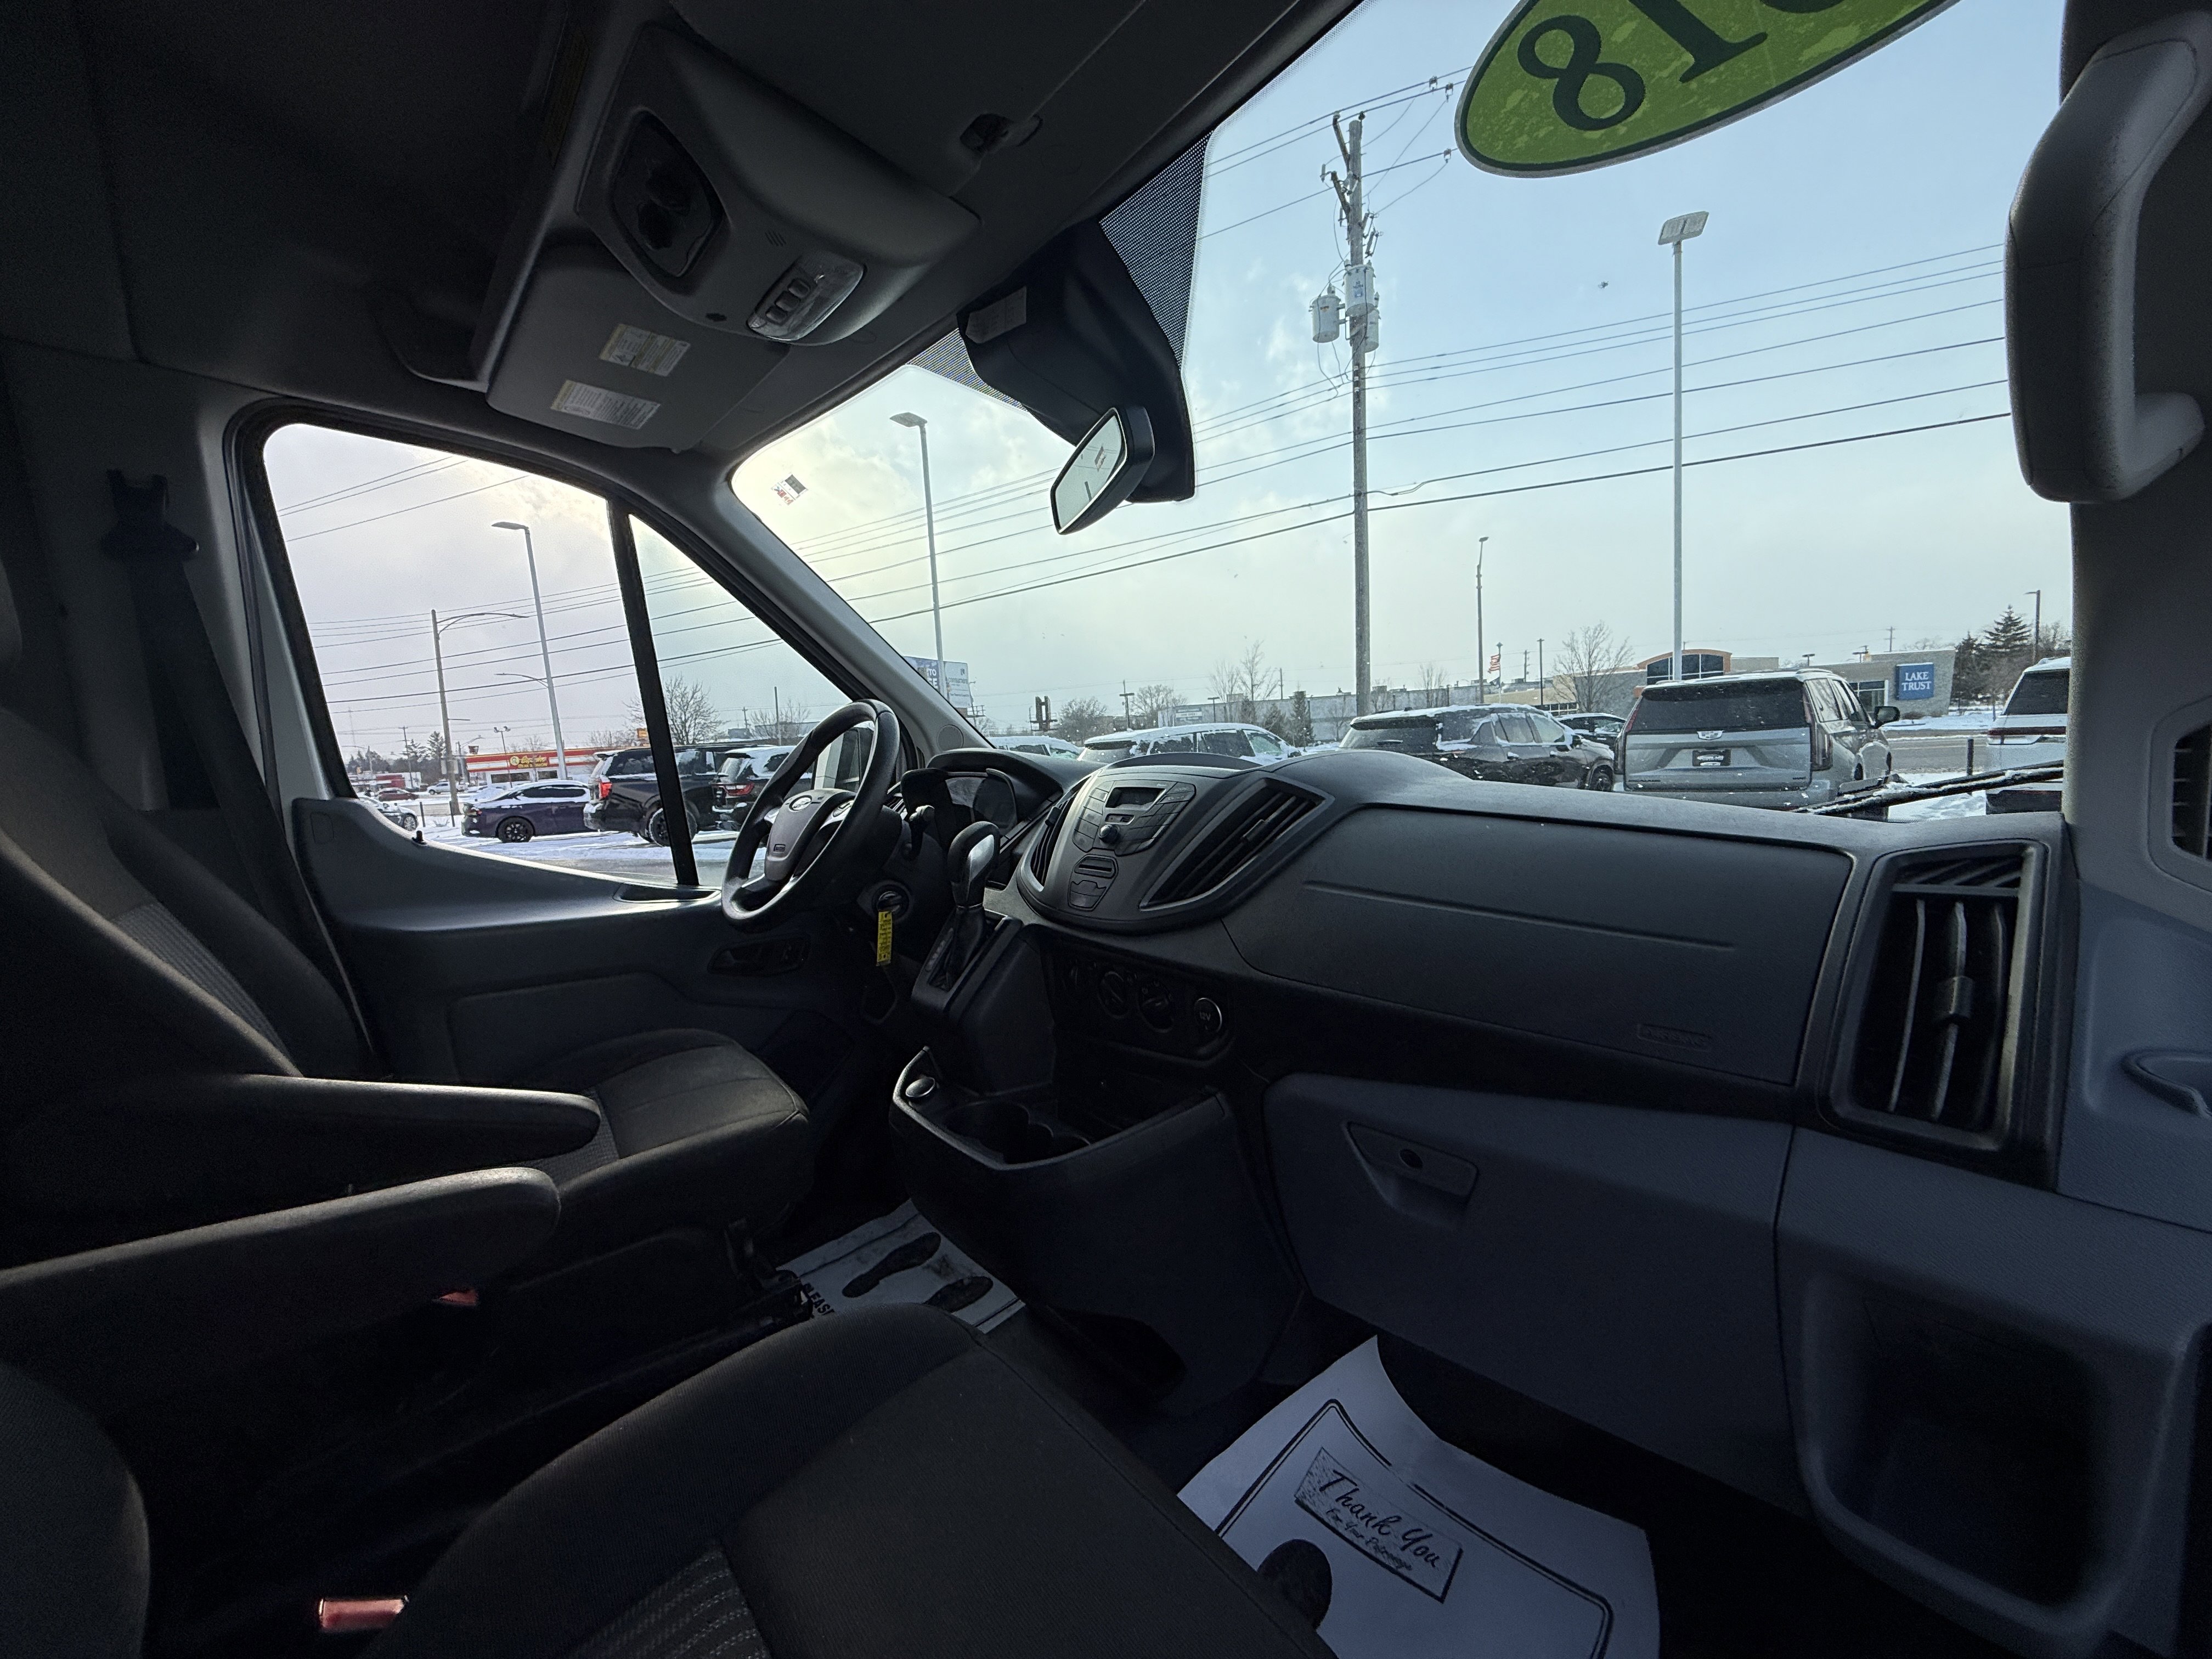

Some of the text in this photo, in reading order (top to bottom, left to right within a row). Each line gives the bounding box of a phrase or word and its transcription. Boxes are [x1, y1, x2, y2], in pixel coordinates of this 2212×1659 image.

[1905, 672, 1929, 681] LAKE
[1901, 681, 1932, 691] TRUST
[1319, 1469, 1440, 1567] Thank You
